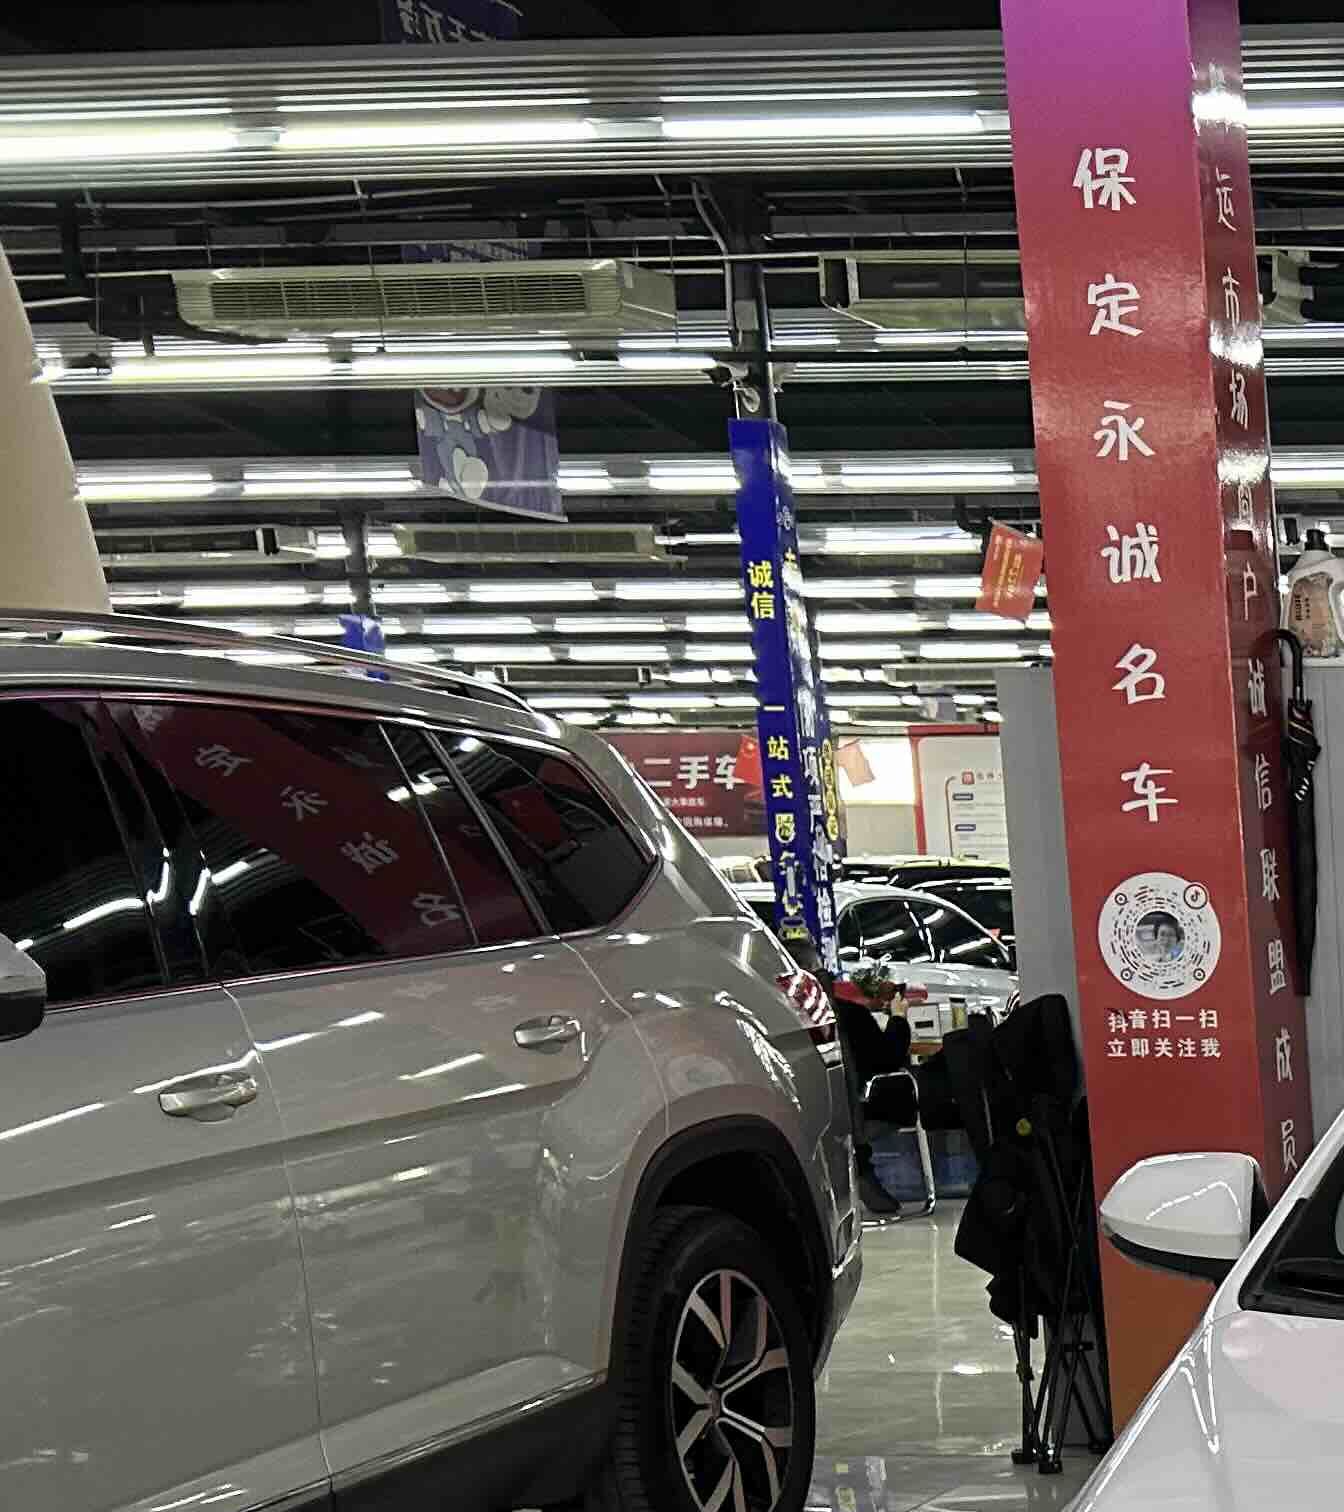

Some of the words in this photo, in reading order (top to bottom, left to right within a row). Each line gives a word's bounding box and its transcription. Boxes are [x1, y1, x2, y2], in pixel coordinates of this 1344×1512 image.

[1072, 147, 1179, 823] 保定永诚名车
[748, 560, 775, 616] 诚信
[1208, 62, 1299, 1173] 运市场商户诚信联盟成员
[1107, 1008, 1219, 1034] 抖音扫一扫
[1107, 1037, 1222, 1058] 立即关注我
